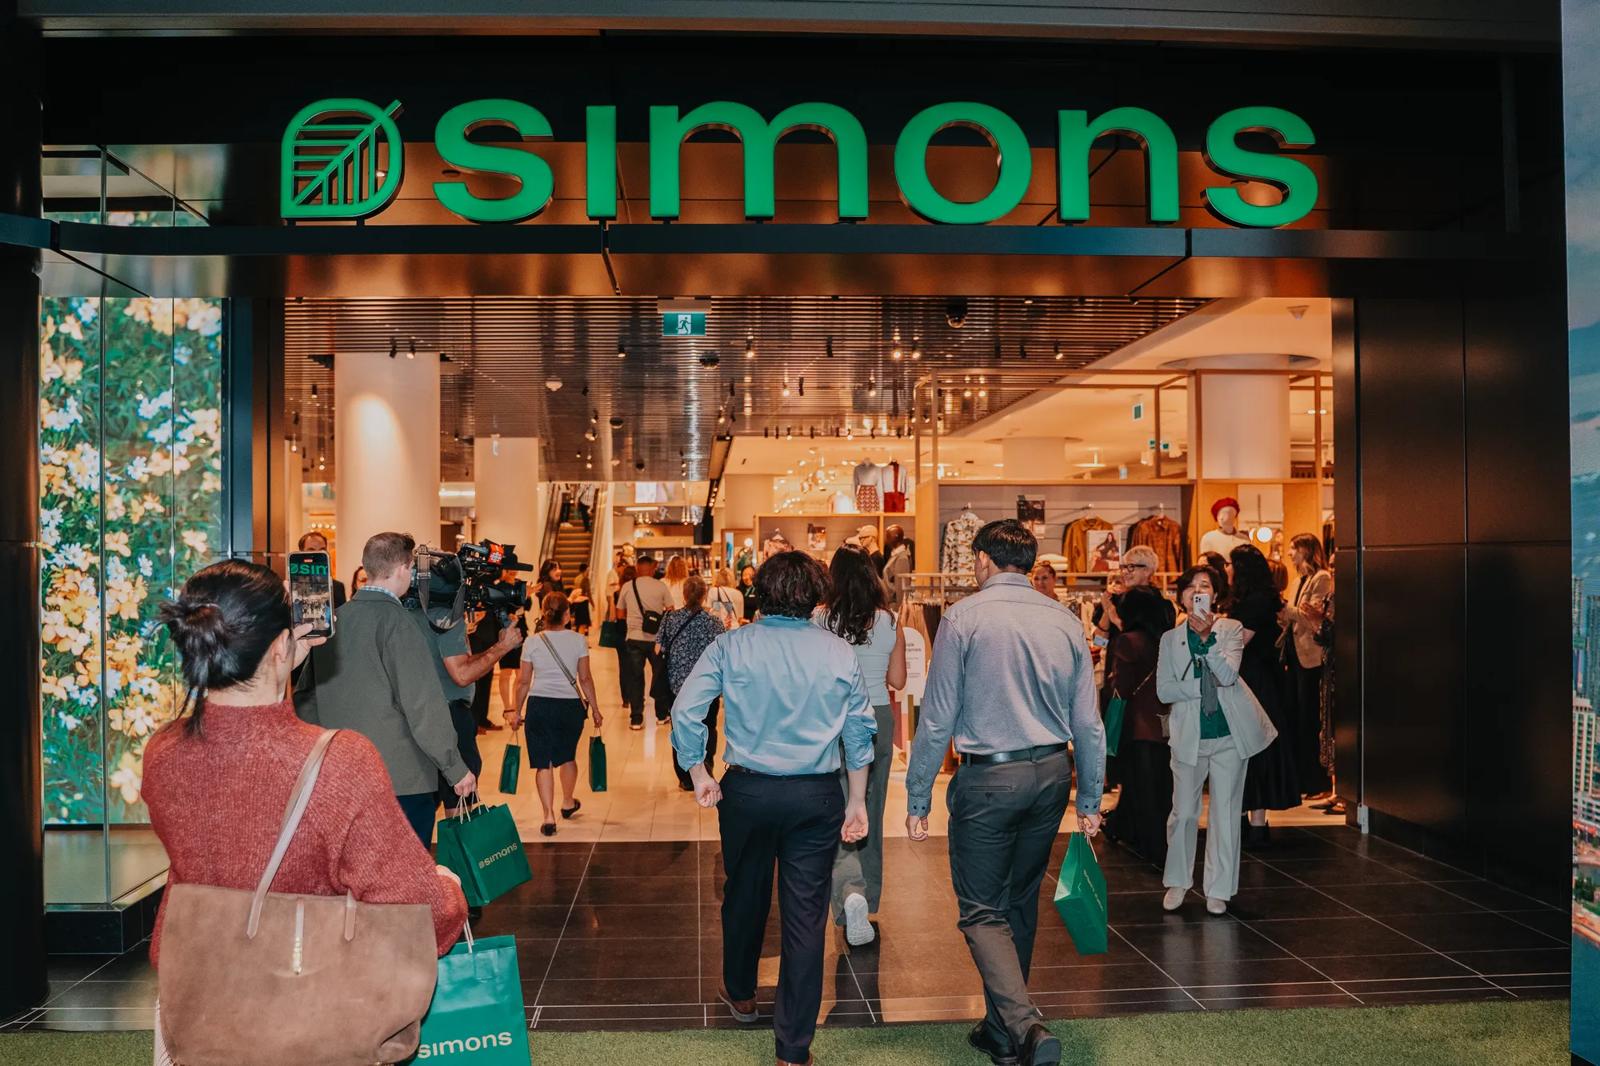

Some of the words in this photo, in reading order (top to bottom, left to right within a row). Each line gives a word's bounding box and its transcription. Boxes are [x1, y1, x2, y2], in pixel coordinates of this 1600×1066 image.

[432, 98, 1320, 228] simons
[484, 842, 519, 867] simons
[417, 1031, 513, 1060] simons
